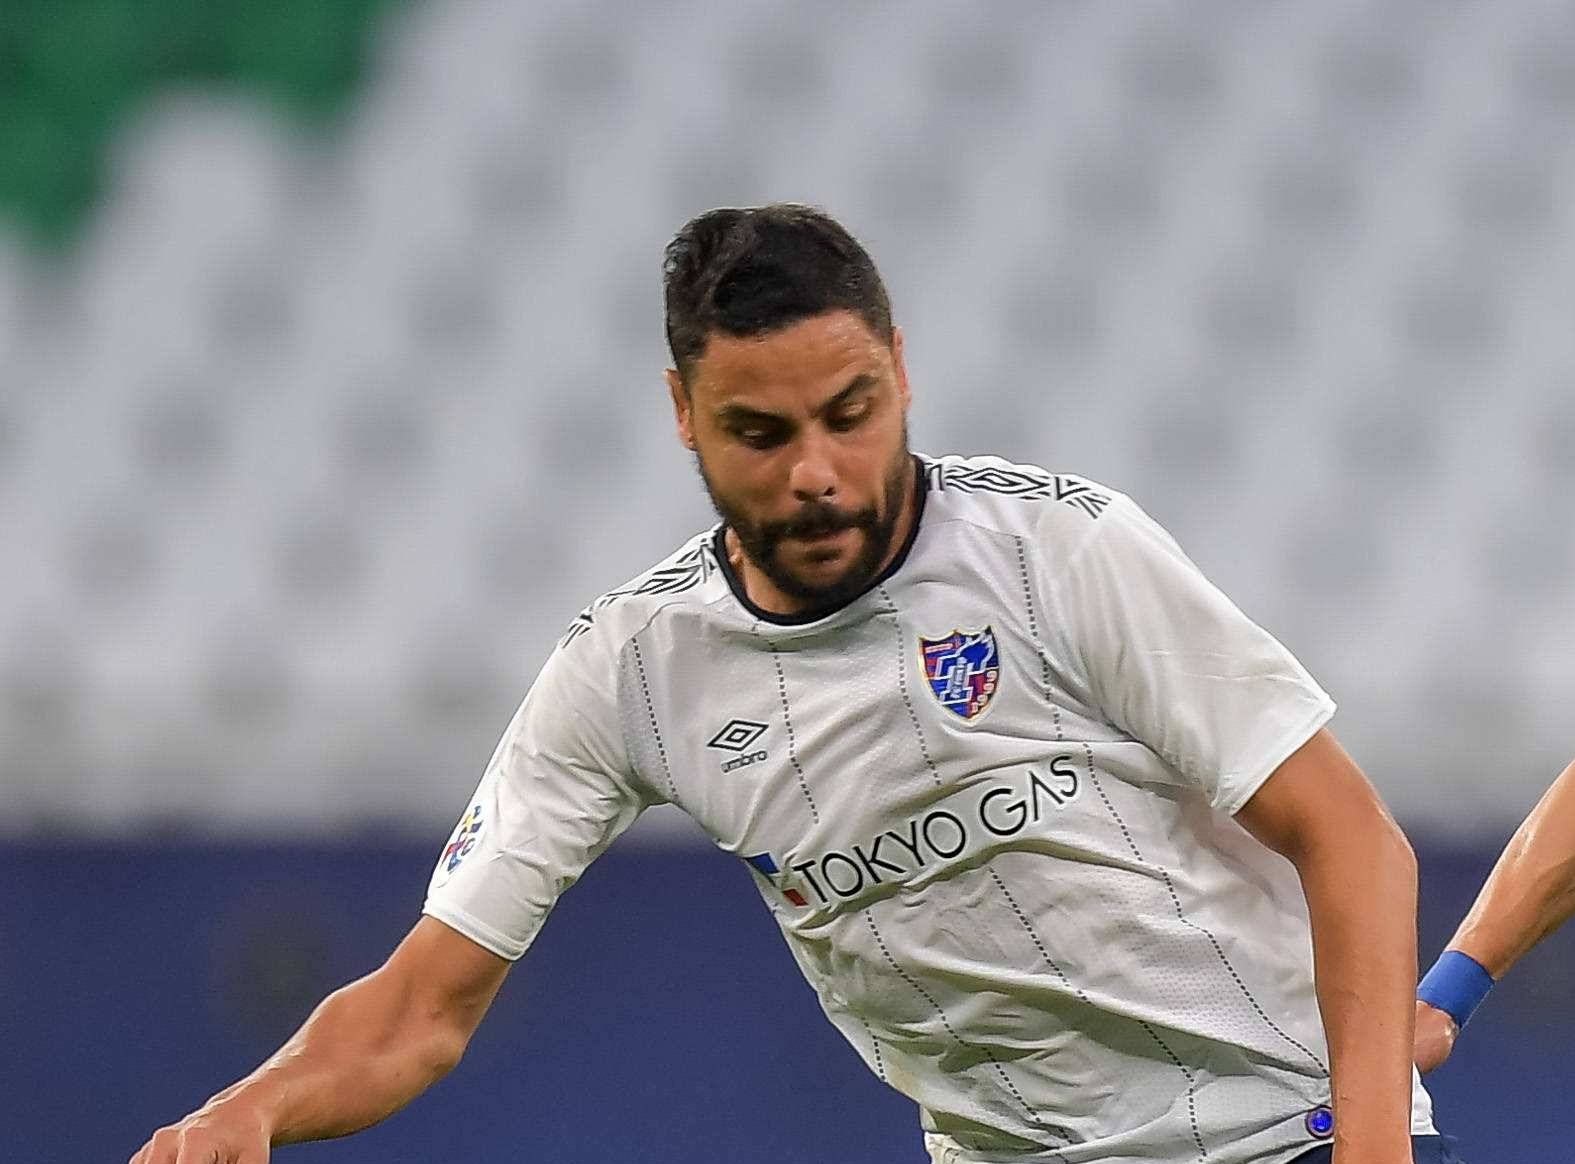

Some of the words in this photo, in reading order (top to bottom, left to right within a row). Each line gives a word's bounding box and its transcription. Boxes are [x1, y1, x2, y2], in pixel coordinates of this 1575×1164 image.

[720, 751, 768, 773] umbro
[791, 811, 966, 903] TOKYO
[979, 755, 1078, 836] GAS
